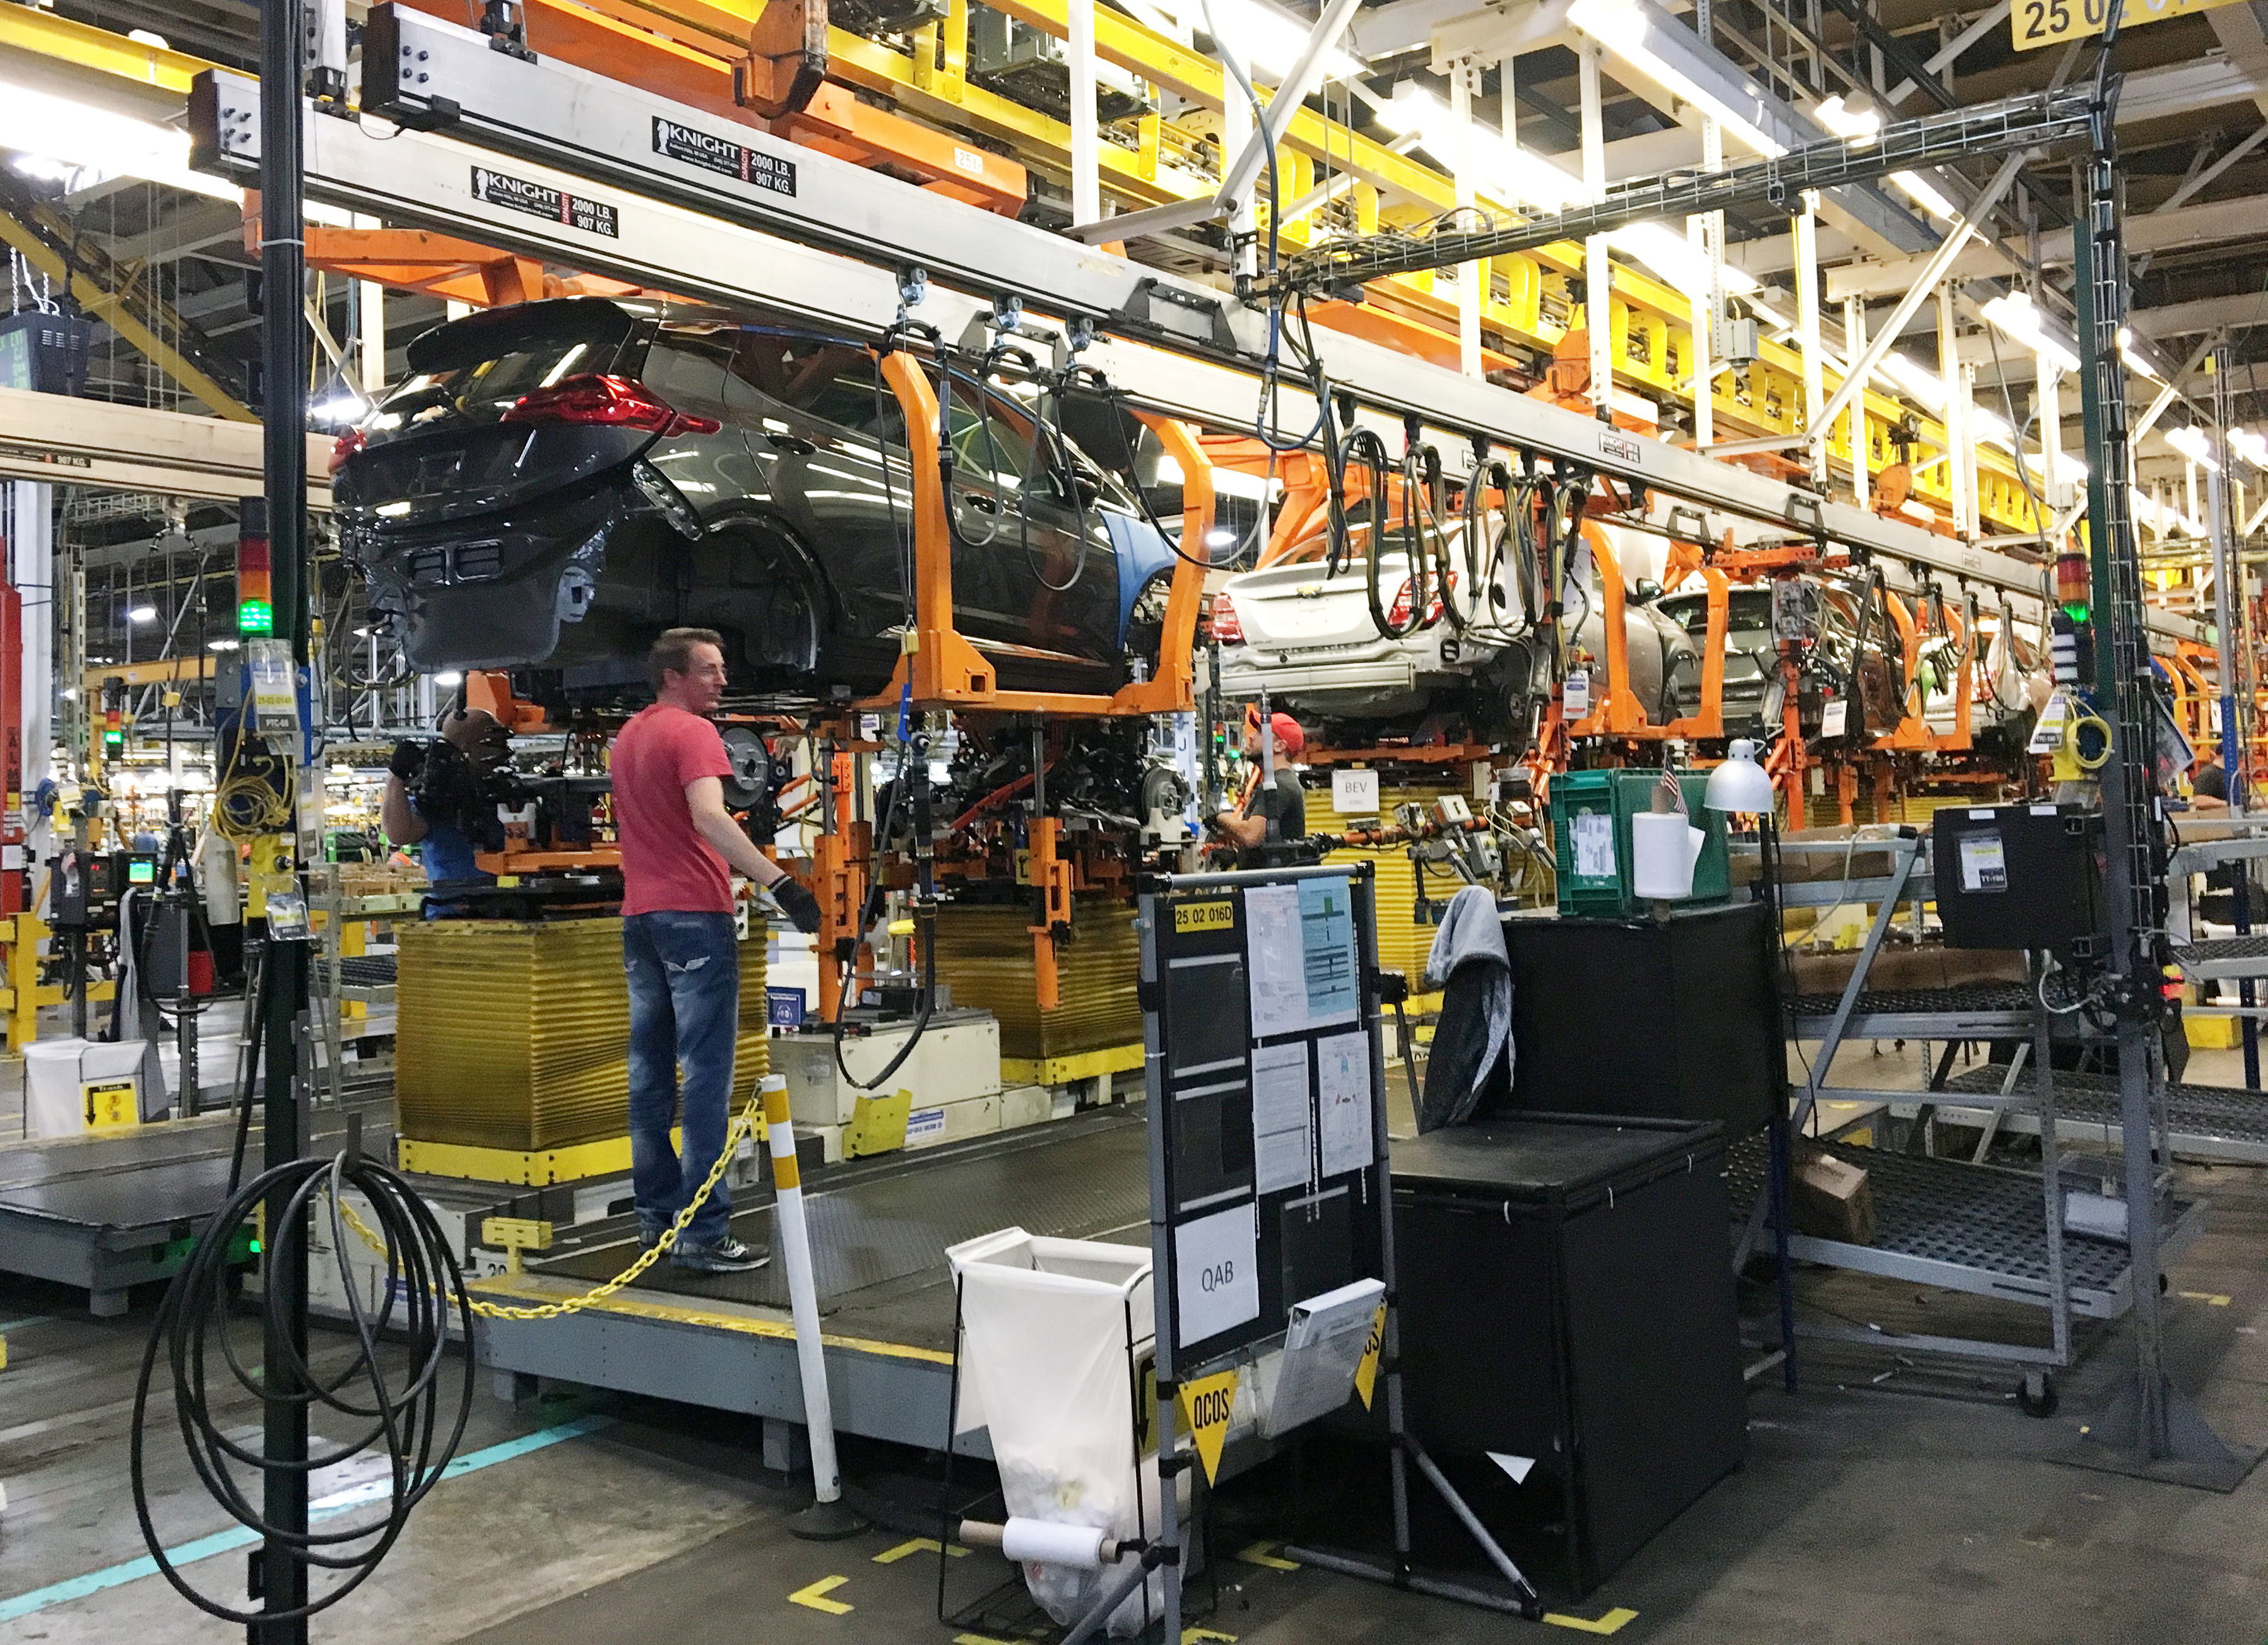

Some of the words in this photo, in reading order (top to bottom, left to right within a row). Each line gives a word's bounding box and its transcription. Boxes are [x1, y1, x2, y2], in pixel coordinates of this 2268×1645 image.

[2025, 0, 2070, 40] 25
[670, 124, 739, 159] KNIGHT
[741, 148, 749, 180] CAPACITY
[751, 152, 773, 171] 2000
[775, 160, 791, 177] LB.
[488, 173, 559, 204] KNIGHT
[756, 172, 772, 187] 907
[774, 177, 791, 194] KG.
[562, 193, 570, 223] CAPACITY
[572, 198, 594, 215] 2000
[596, 205, 613, 220] LB.
[577, 215, 593, 230] 907
[596, 220, 614, 236] KG.
[1345, 782, 1367, 793] BEV
[1176, 909, 1189, 924] 25
[1193, 909, 1205, 923] 02
[1208, 906, 1232, 921] 016D
[1202, 1261, 1234, 1292] QAB
[1194, 1388, 1229, 1430] QCOS
